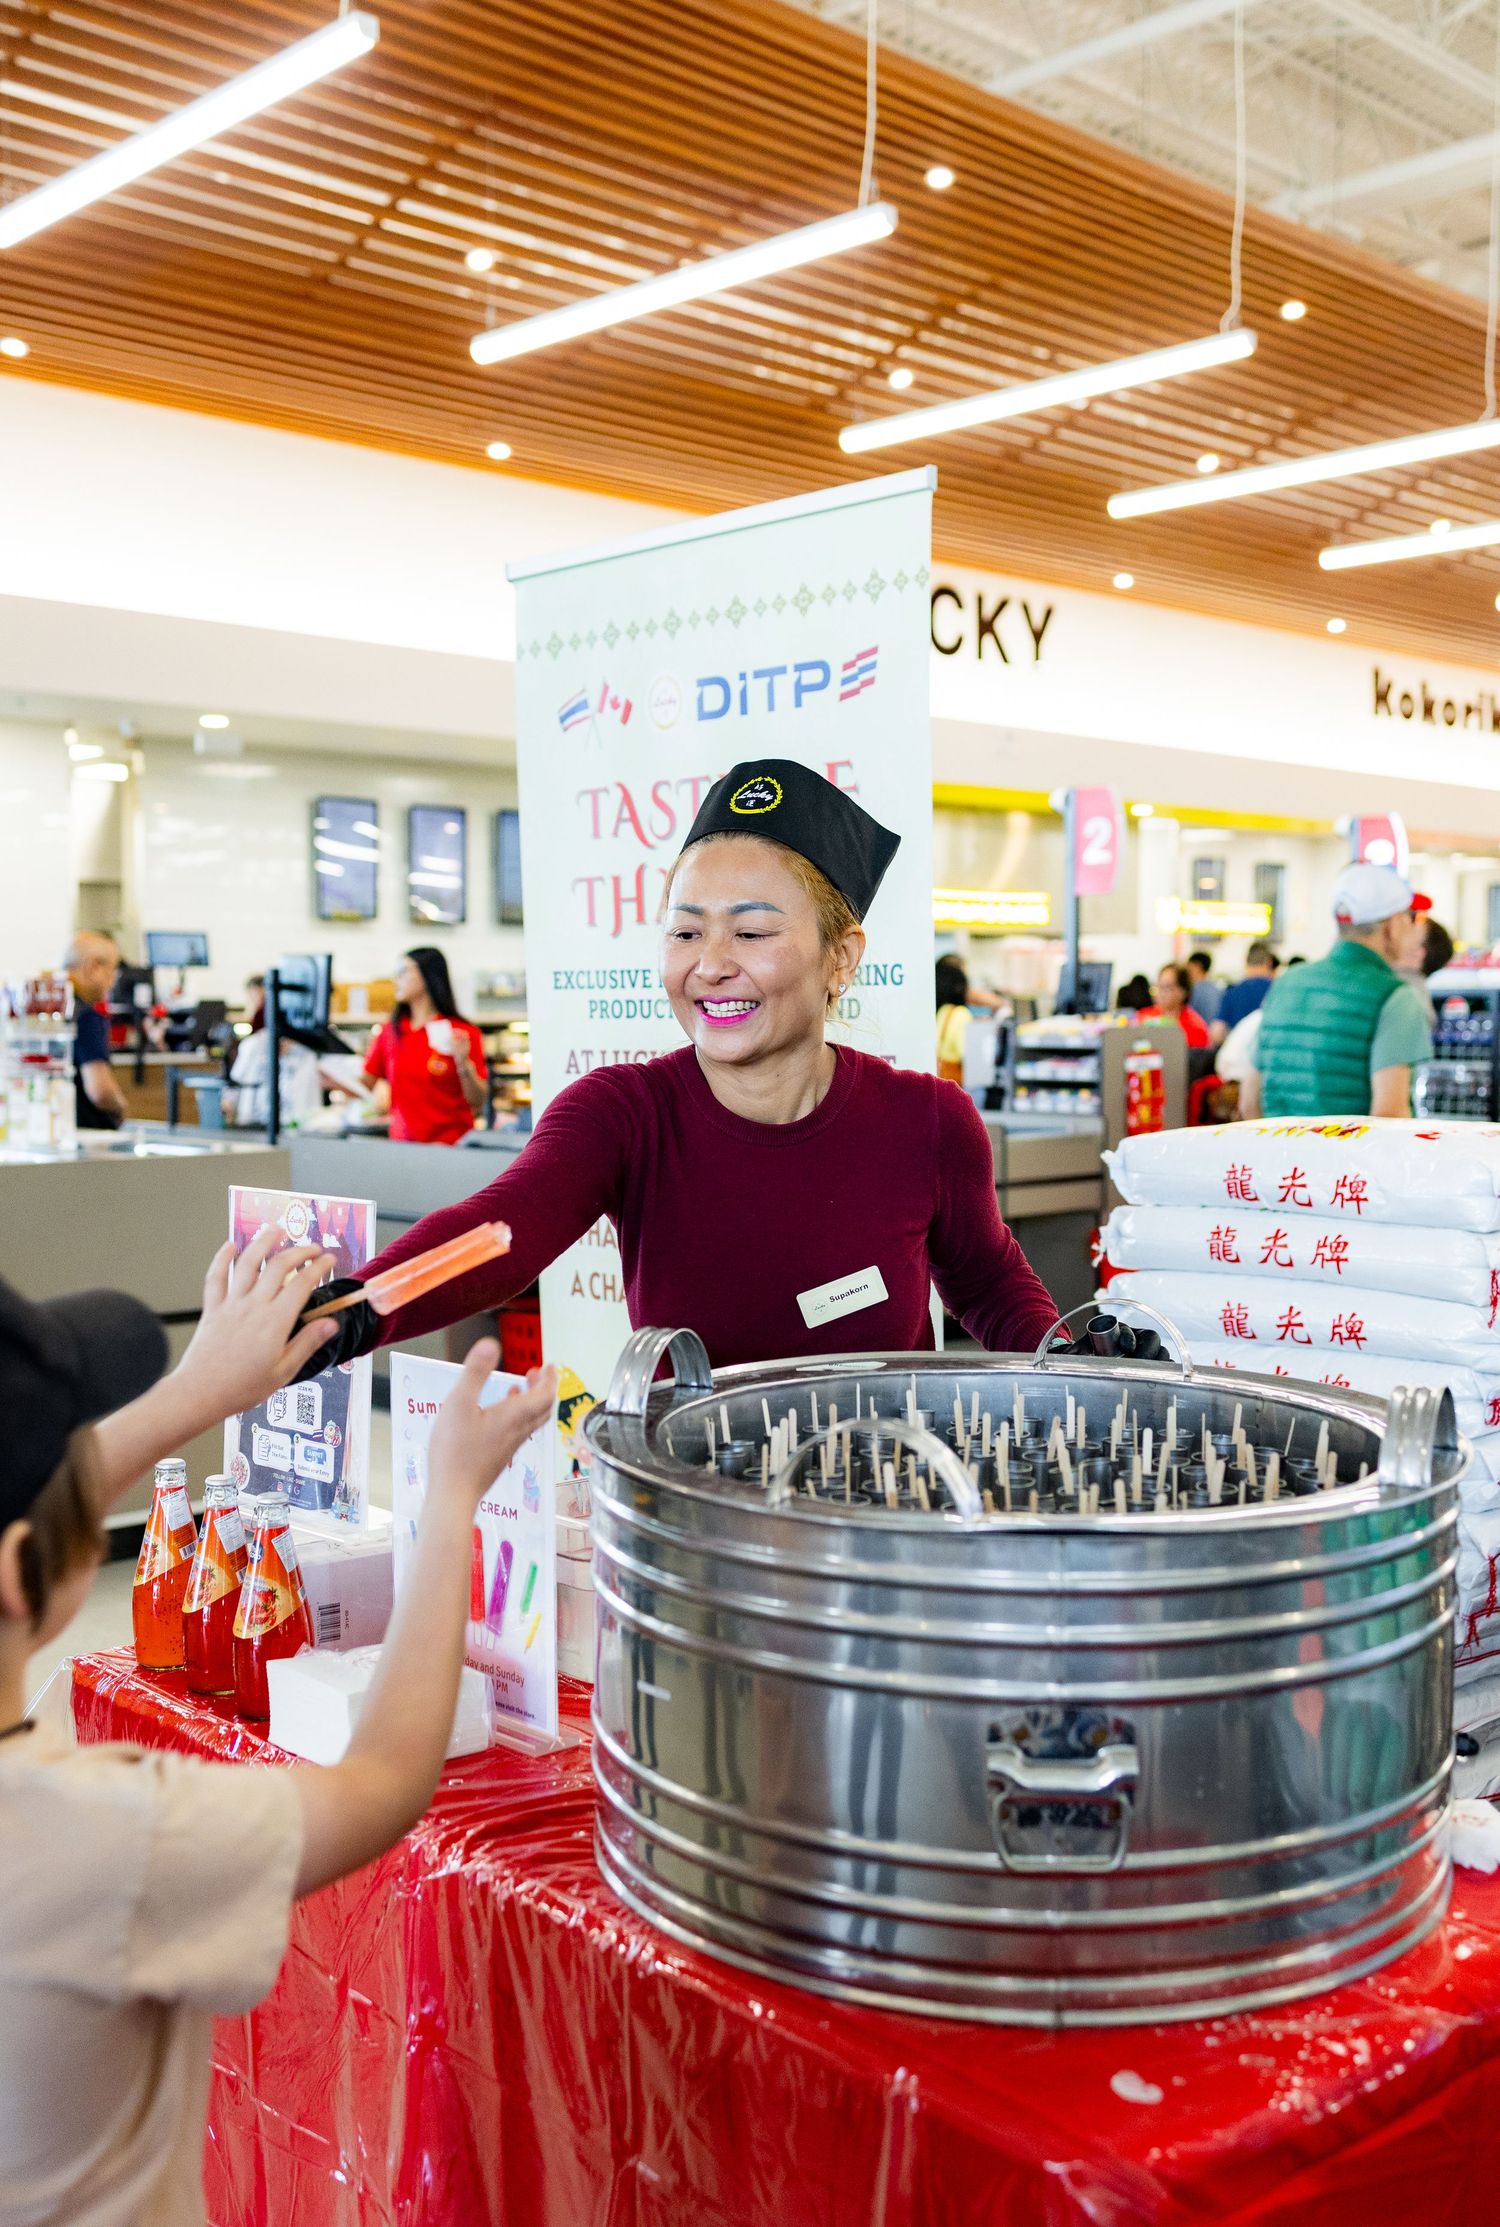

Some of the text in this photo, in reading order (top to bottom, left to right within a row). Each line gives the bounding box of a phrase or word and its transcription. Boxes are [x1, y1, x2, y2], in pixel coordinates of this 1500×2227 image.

[736, 789, 774, 802] Lucky
[575, 771, 727, 850] TAST
[1081, 815, 1113, 866] 2
[552, 968, 653, 990] EXCLUSIVE
[828, 1283, 870, 1304] Supakorn
[480, 1501, 519, 1521] CREAM
[464, 1656, 525, 1688] day and Sunday
[496, 1680, 509, 1694] PM
